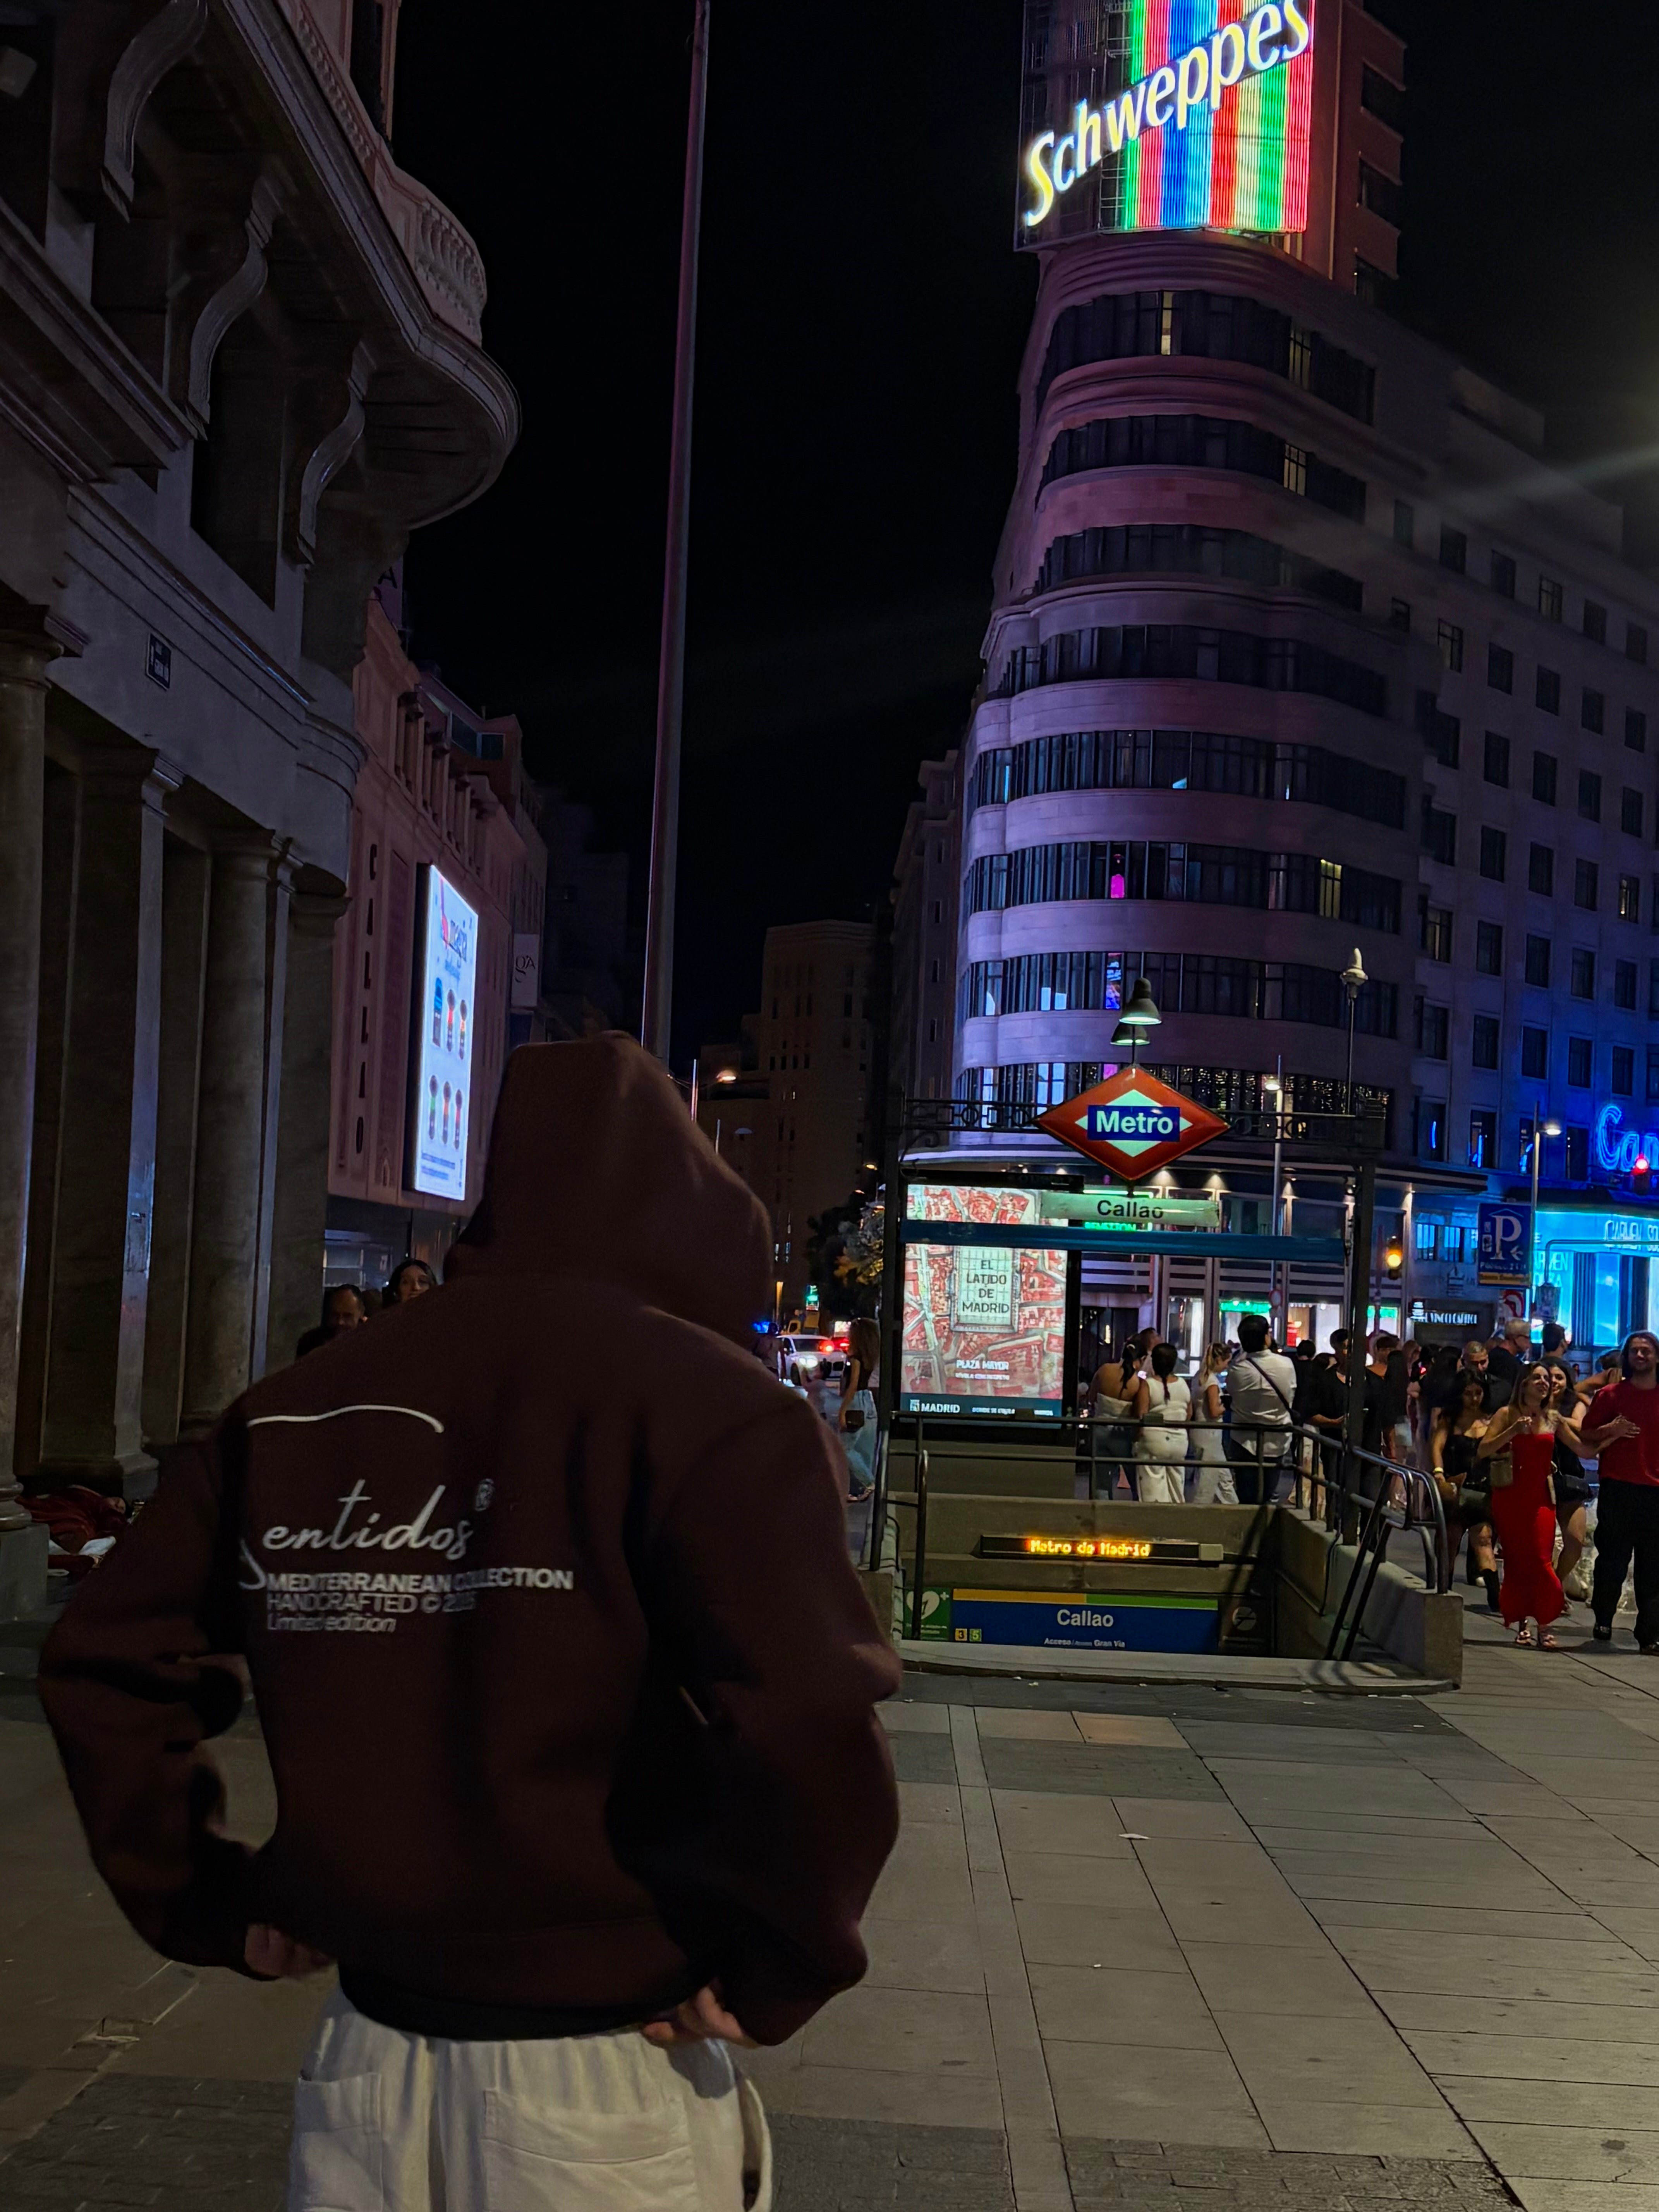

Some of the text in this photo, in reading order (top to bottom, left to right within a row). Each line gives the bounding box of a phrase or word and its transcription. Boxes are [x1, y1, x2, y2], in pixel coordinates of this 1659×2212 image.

[1025, 0, 1309, 226] Schweppes
[1096, 1109, 1173, 1135] Metro
[1097, 1200, 1164, 1219] Callao
[1491, 1215, 1522, 1260] P
[981, 1260, 994, 1270] EL
[967, 1273, 1007, 1285] LATIDO
[978, 1288, 994, 1298] DE
[962, 1301, 1010, 1314] MADRID
[956, 1359, 1009, 1370] PLAZA MAYOR
[921, 1403, 960, 1413] MADRID
[1030, 1540, 1072, 1553] Metro
[1100, 1542, 1151, 1557] Madrid
[268, 1572, 452, 1592] MEDITERRANEAN
[267, 1592, 418, 1613] HANDCRAFTED
[1057, 1609, 1114, 1627] Callao
